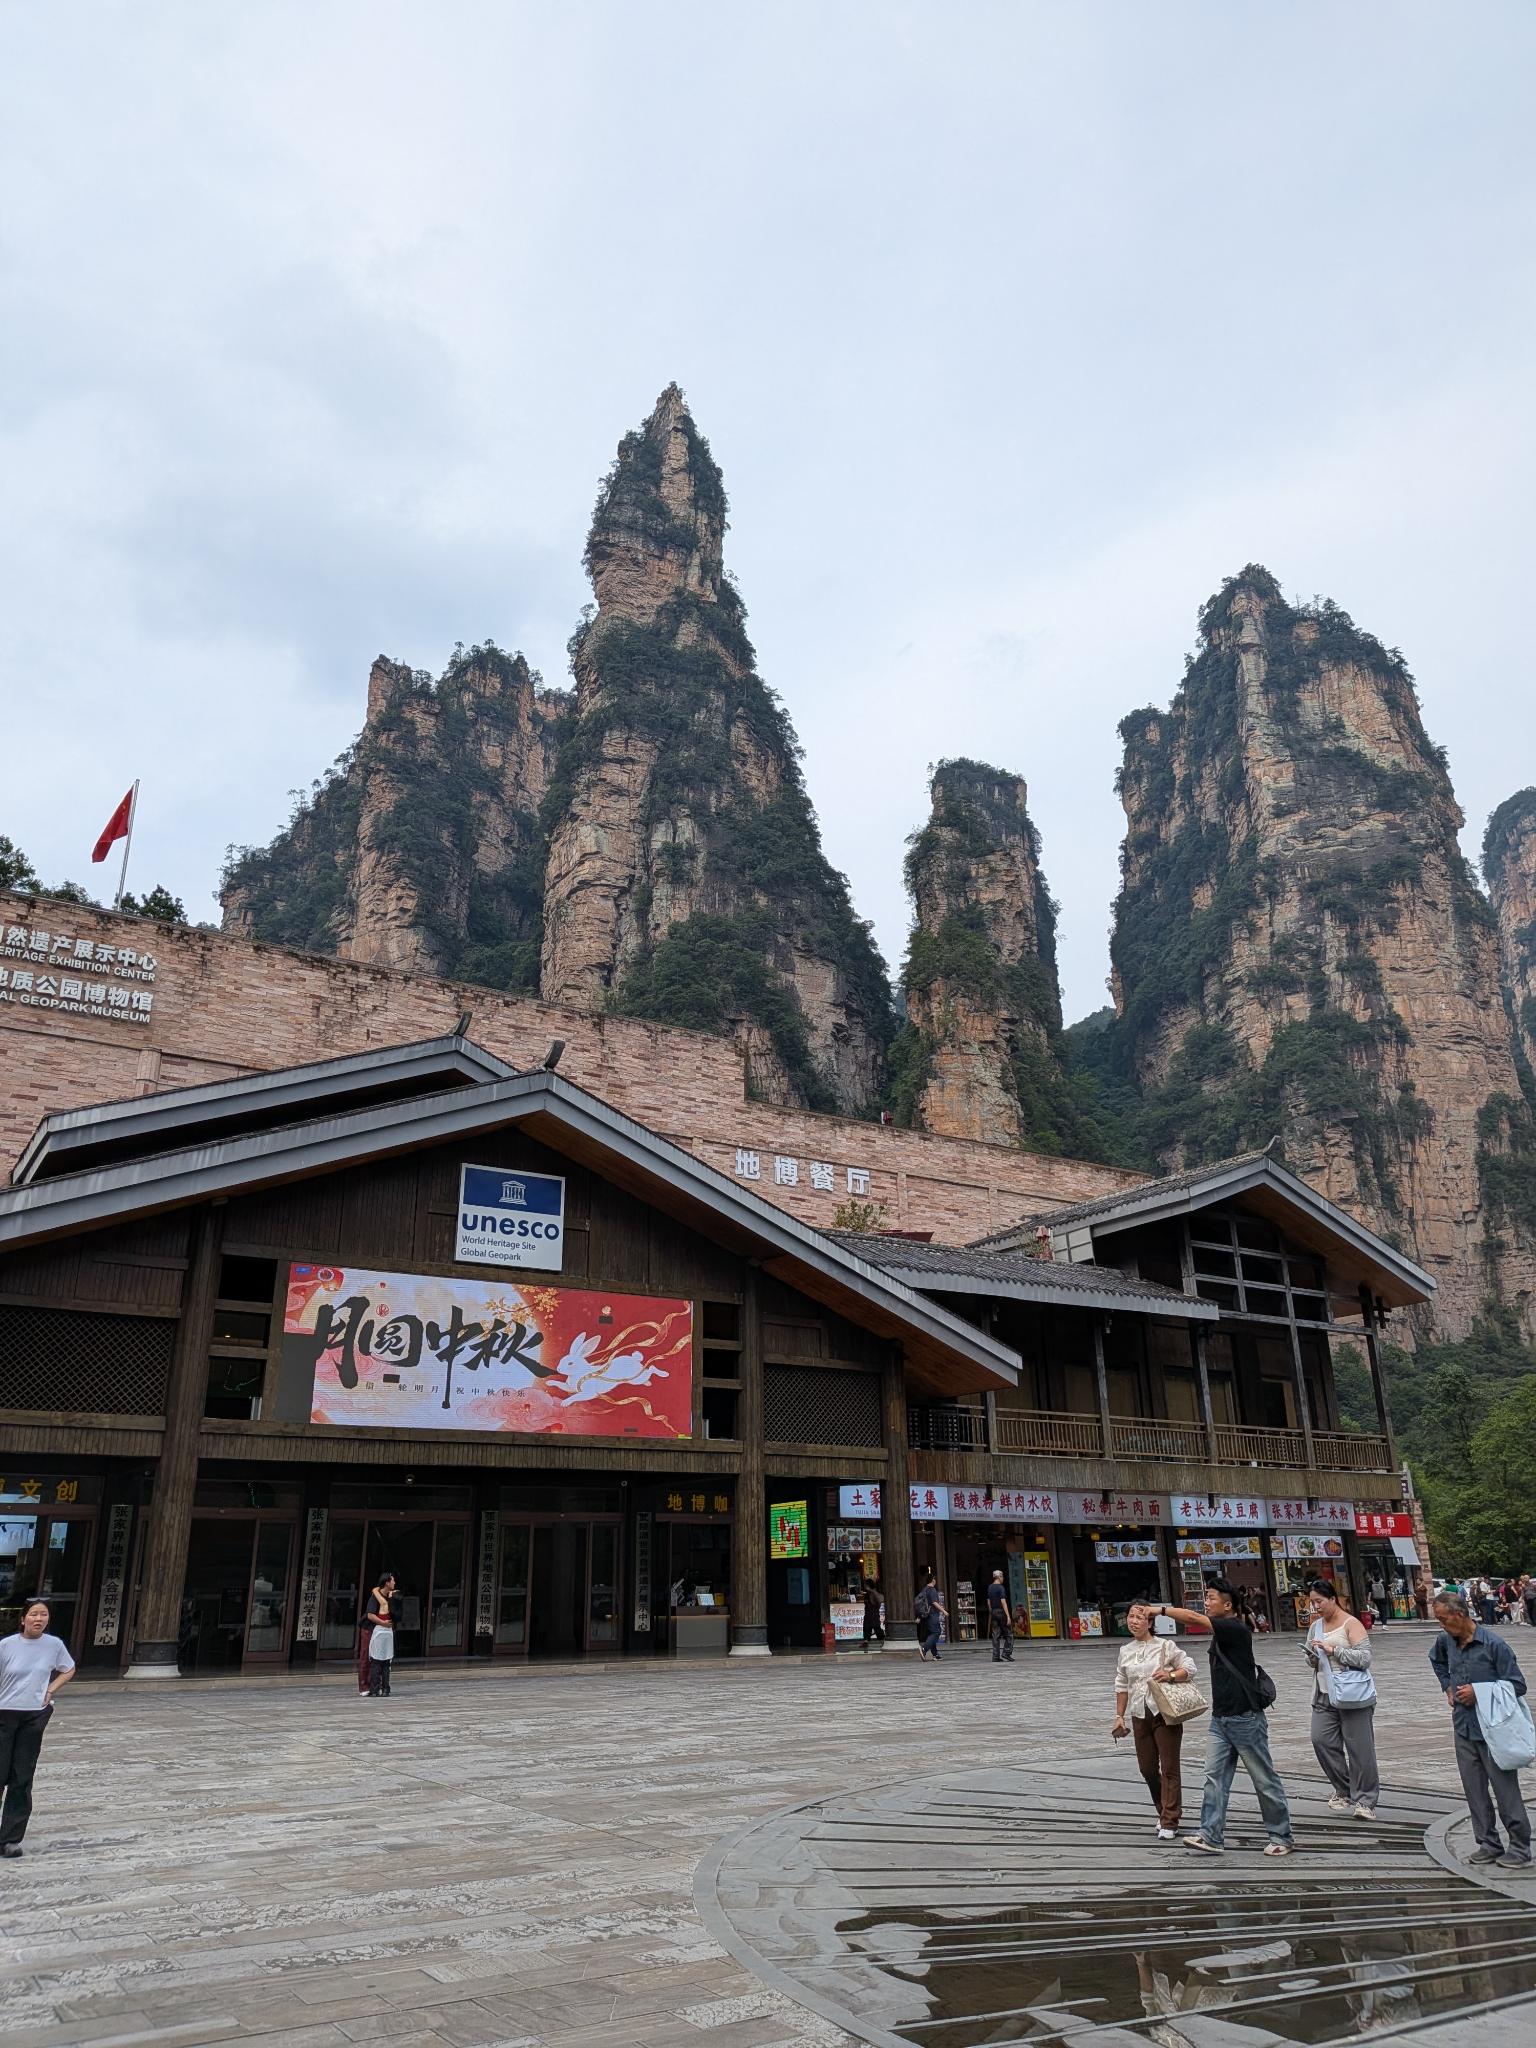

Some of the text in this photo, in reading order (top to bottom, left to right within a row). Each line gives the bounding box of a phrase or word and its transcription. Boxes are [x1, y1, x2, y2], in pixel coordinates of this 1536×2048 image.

[49, 955, 110, 974] EXHIBITION
[114, 967, 155, 981] CENTER
[20, 994, 88, 1012] GEOPARK
[91, 1005, 150, 1023] MUSEUM
[735, 1148, 870, 1195] 地博餐厅
[462, 1213, 560, 1240] unesco
[461, 1248, 521, 1261] Global Geopark
[462, 1235, 536, 1250] World Heritage Site
[312, 1296, 568, 1409] 月圆中秋
[0, 1478, 78, 1501] 文创
[667, 1494, 728, 1512] 地博咖
